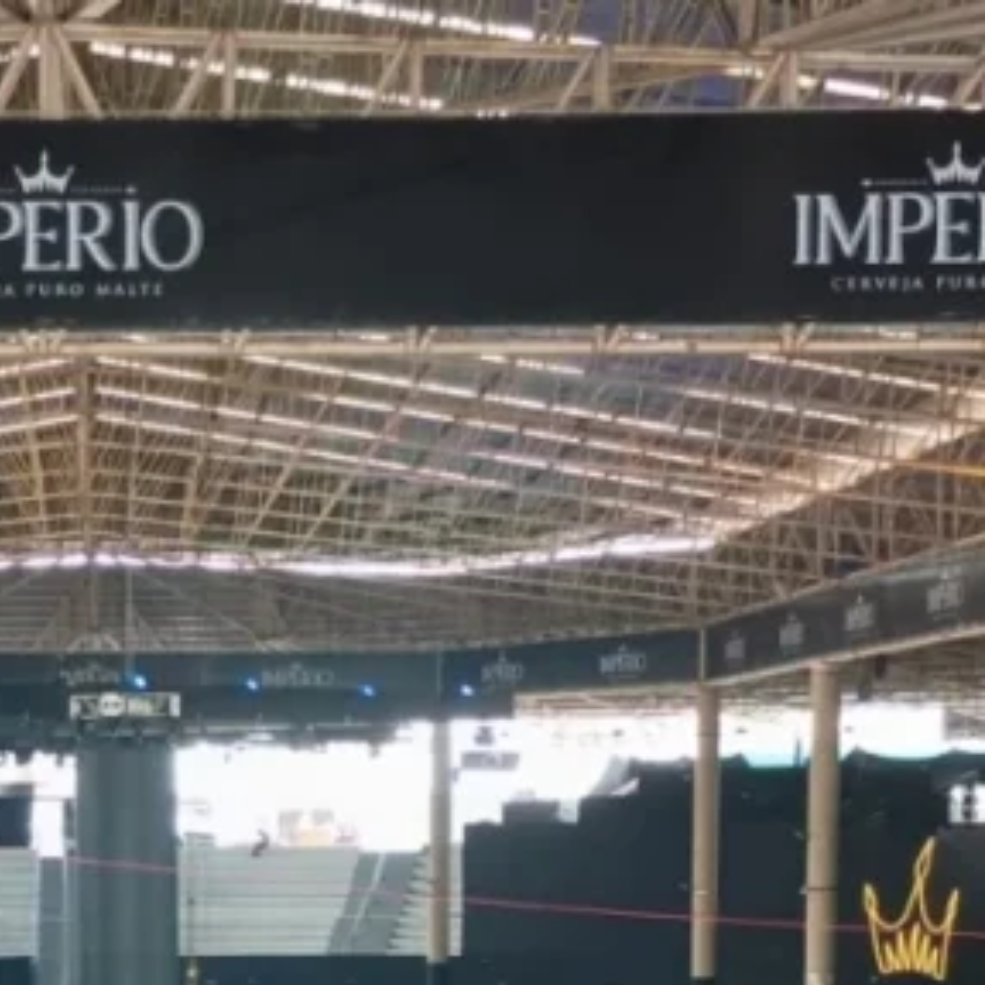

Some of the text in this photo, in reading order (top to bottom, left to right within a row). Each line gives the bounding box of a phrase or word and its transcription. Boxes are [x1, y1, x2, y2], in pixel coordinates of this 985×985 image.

[793, 191, 985, 265] IMPE
[25, 282, 85, 298] PURO
[95, 282, 164, 297] MALTE
